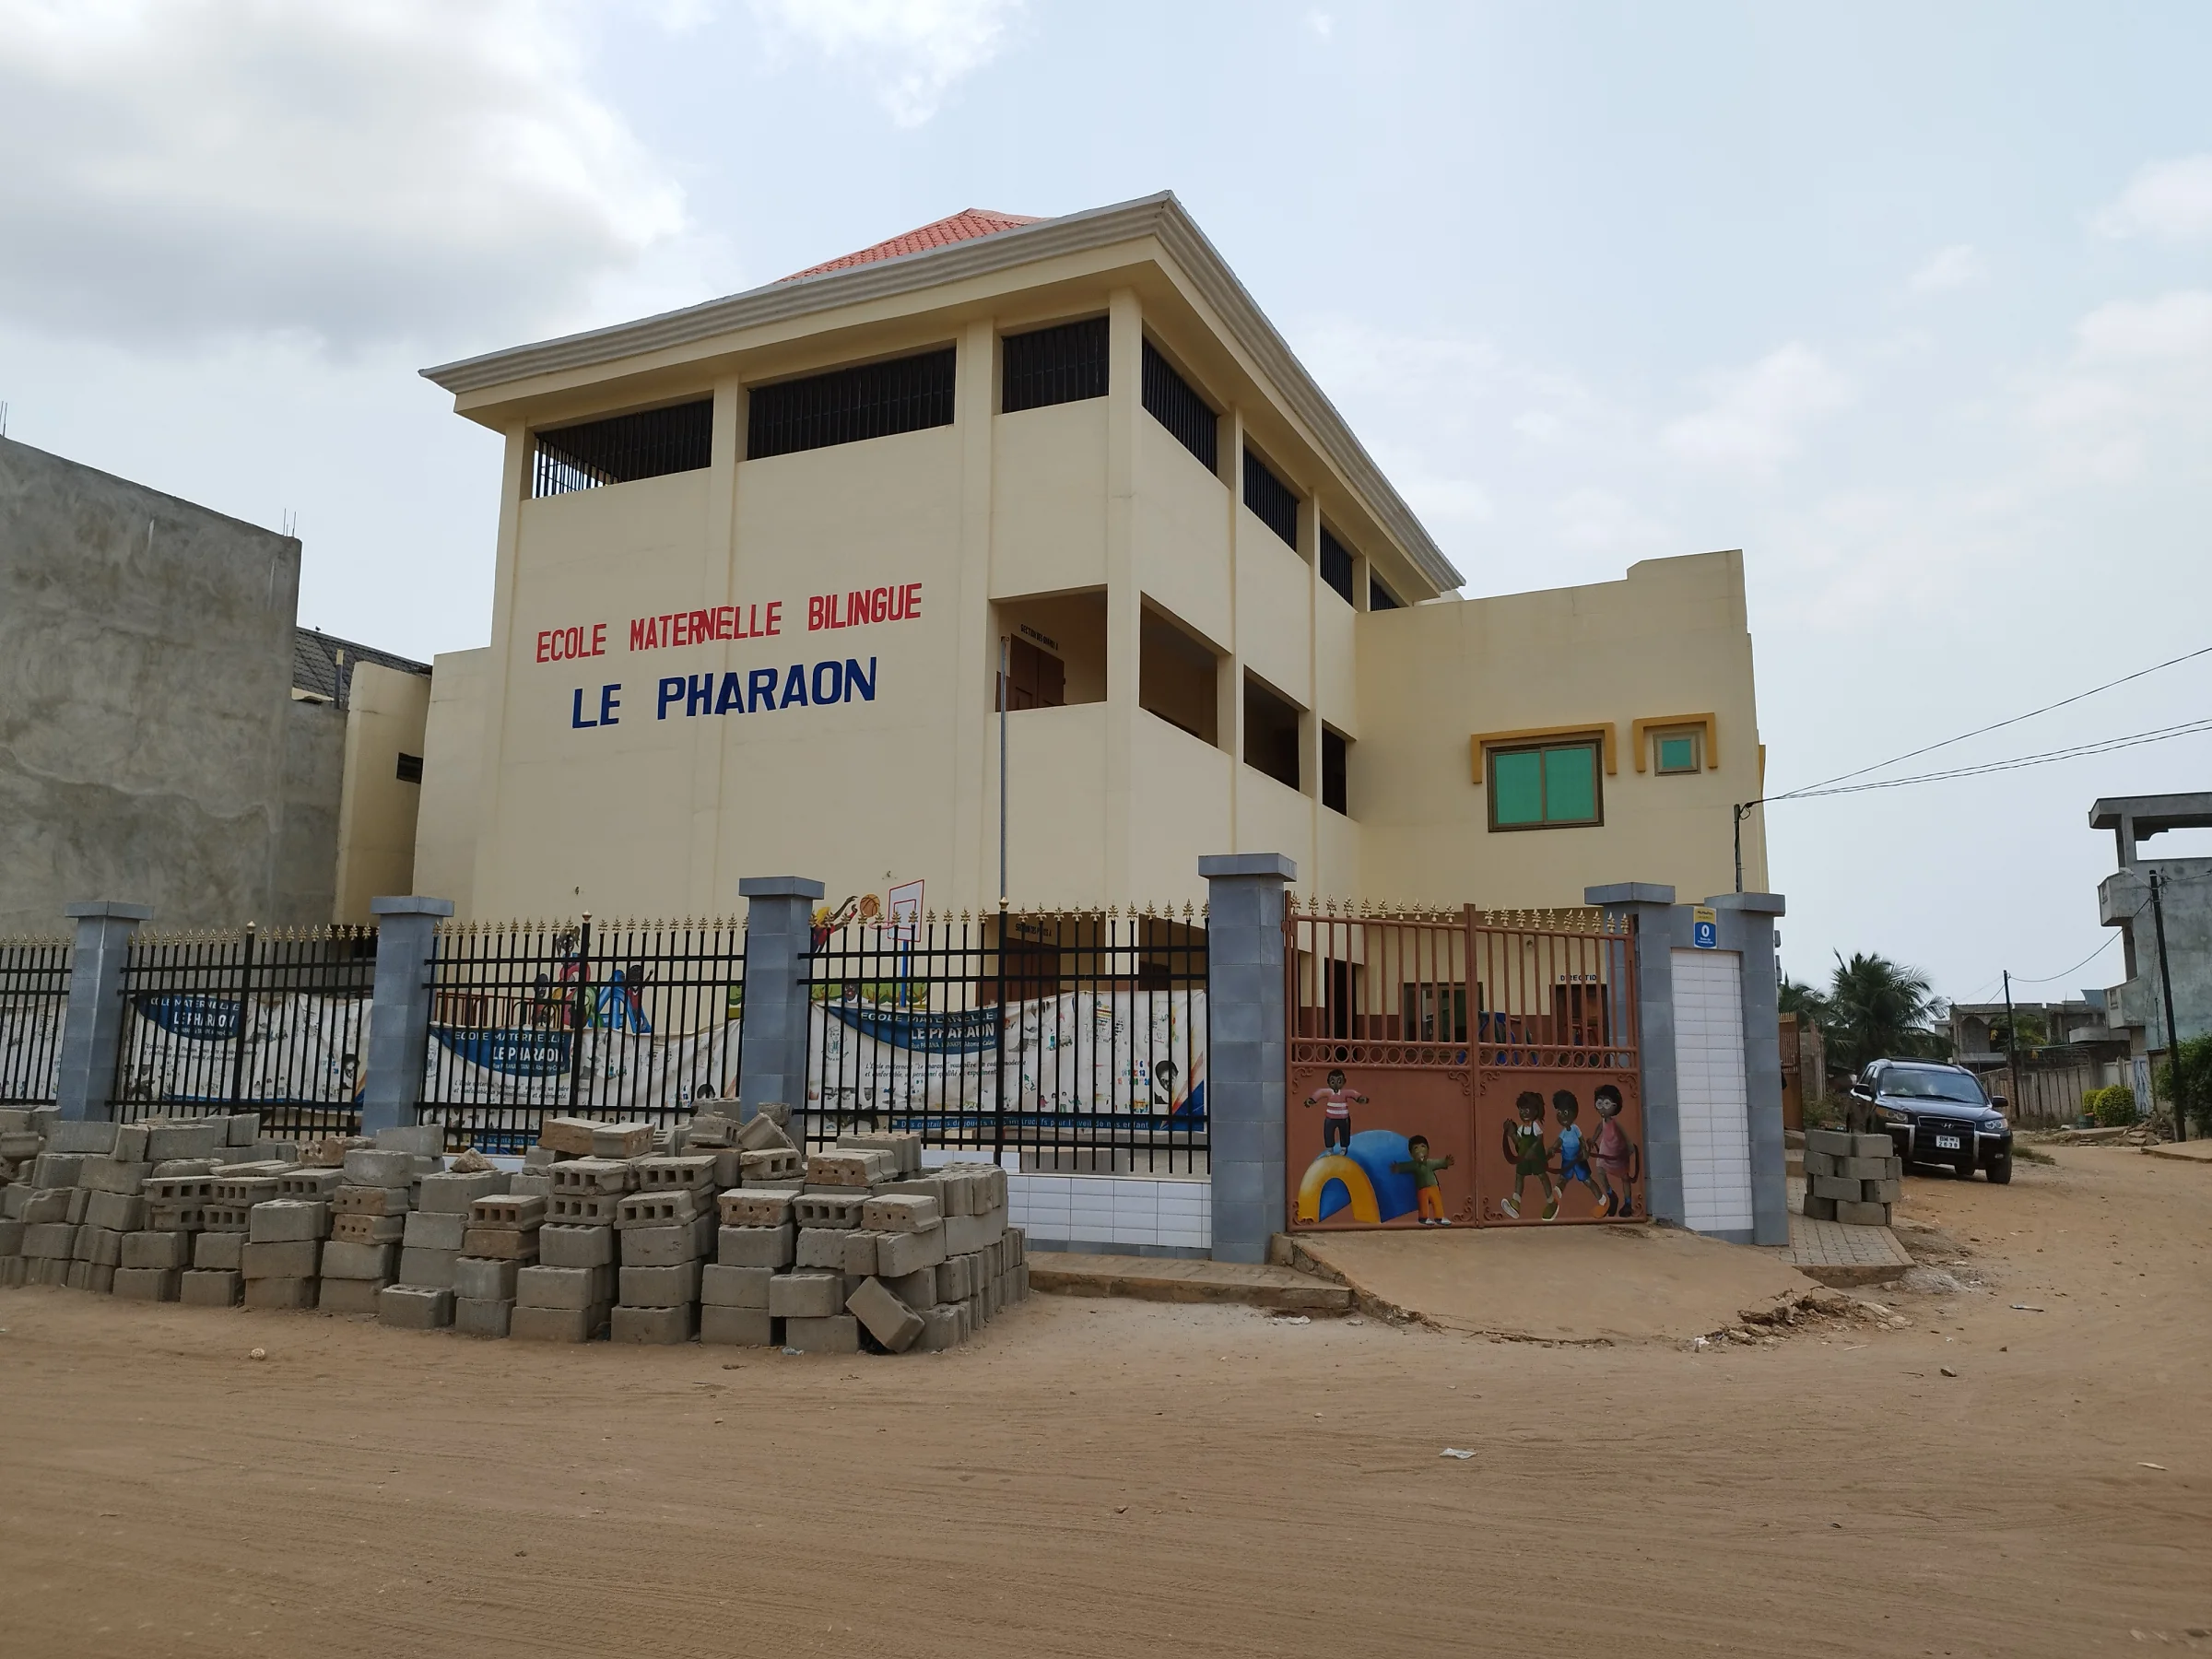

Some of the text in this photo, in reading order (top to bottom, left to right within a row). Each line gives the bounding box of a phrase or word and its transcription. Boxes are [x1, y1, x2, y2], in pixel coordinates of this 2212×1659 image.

[536, 582, 923, 664] ECOLE MATERNELLE BILINGUE
[571, 656, 877, 729] LE PHARAON
[1701, 924, 1710, 938] 0
[148, 997, 171, 1006] COLE
[907, 1012, 994, 1023] MAENELE
[494, 1032, 565, 1043] MTERNELE
[912, 1028, 925, 1041] LE
[964, 1038, 995, 1048] Abome-Calavi
[493, 1047, 506, 1061] LE
